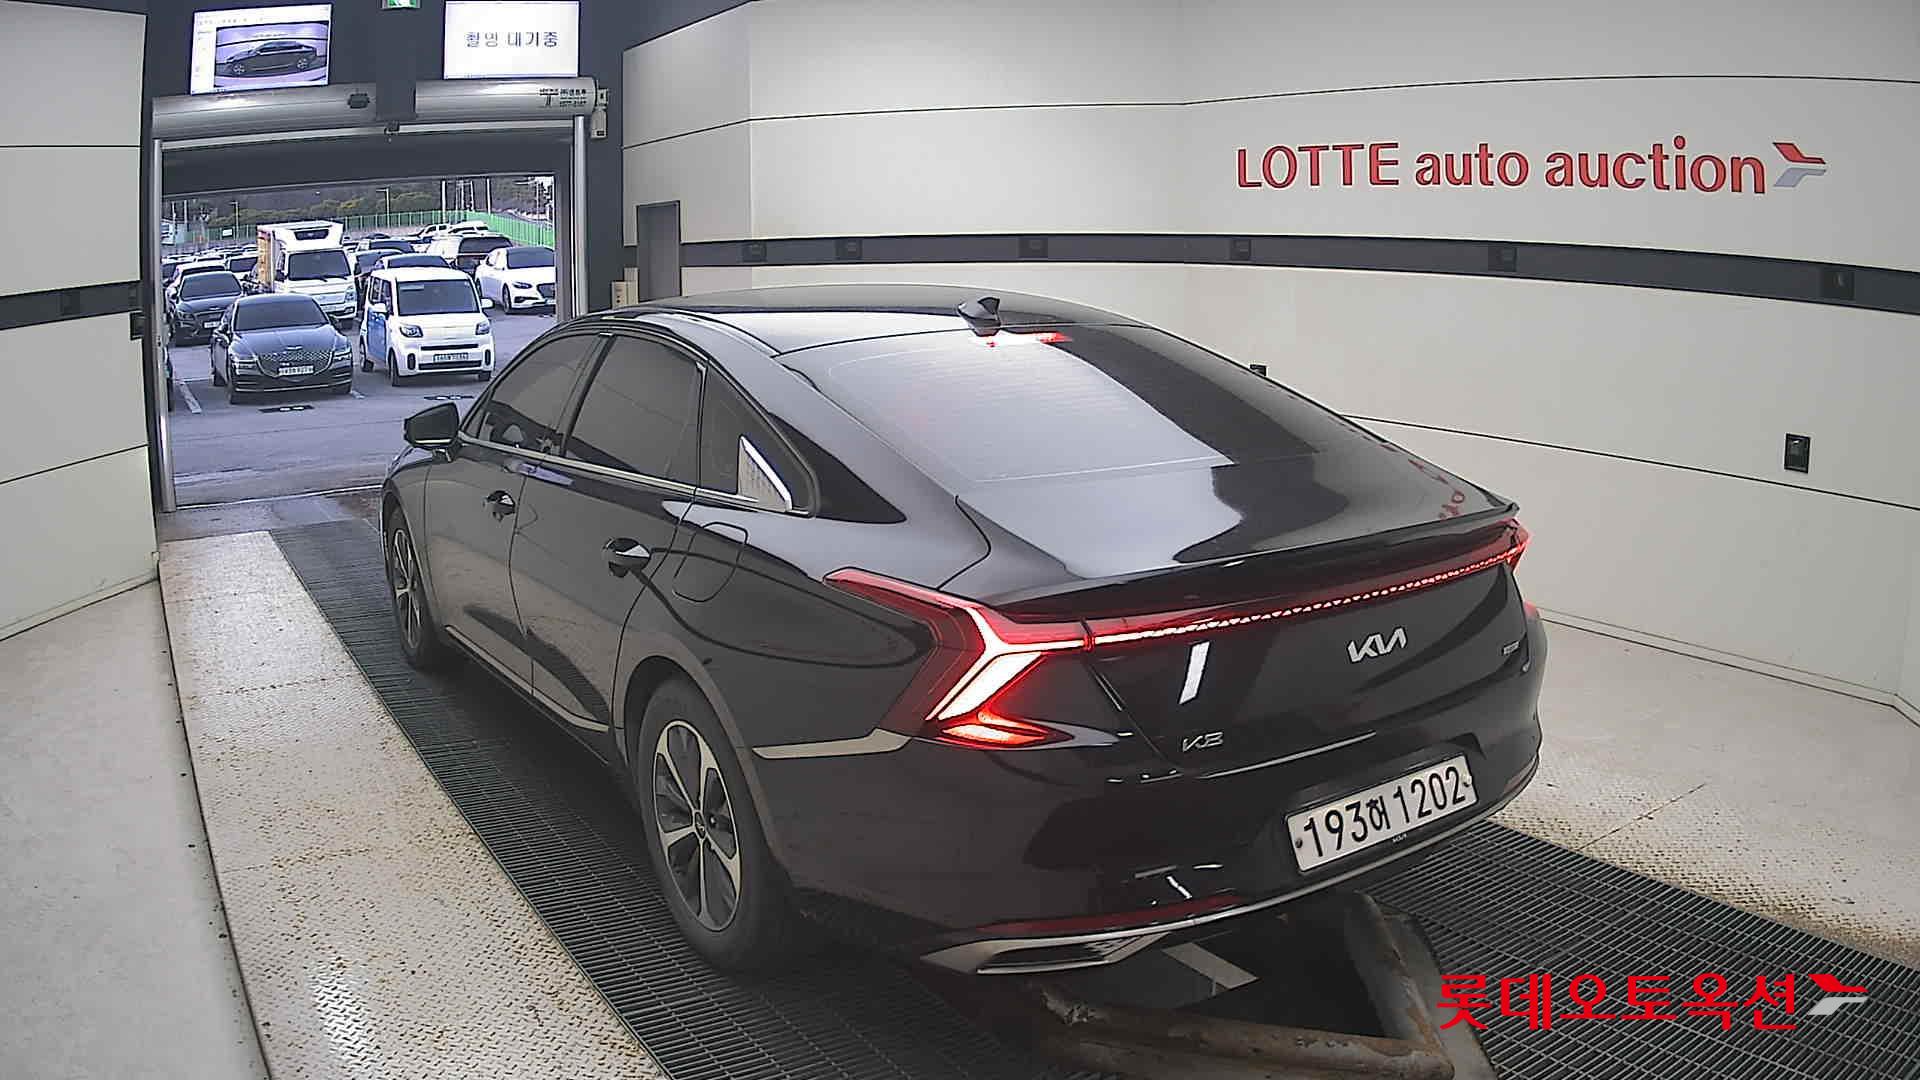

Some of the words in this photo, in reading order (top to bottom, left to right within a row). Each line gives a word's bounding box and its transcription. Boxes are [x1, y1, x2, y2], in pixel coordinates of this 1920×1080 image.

[507, 31, 558, 48] 대기중
[1237, 143, 1399, 189] LOTTE
[1415, 143, 1529, 188] auto
[1545, 135, 1767, 194] auction
[1347, 628, 1408, 663] KIA
[1182, 731, 1224, 752] K8
[1393, 766, 1466, 823] 1202
